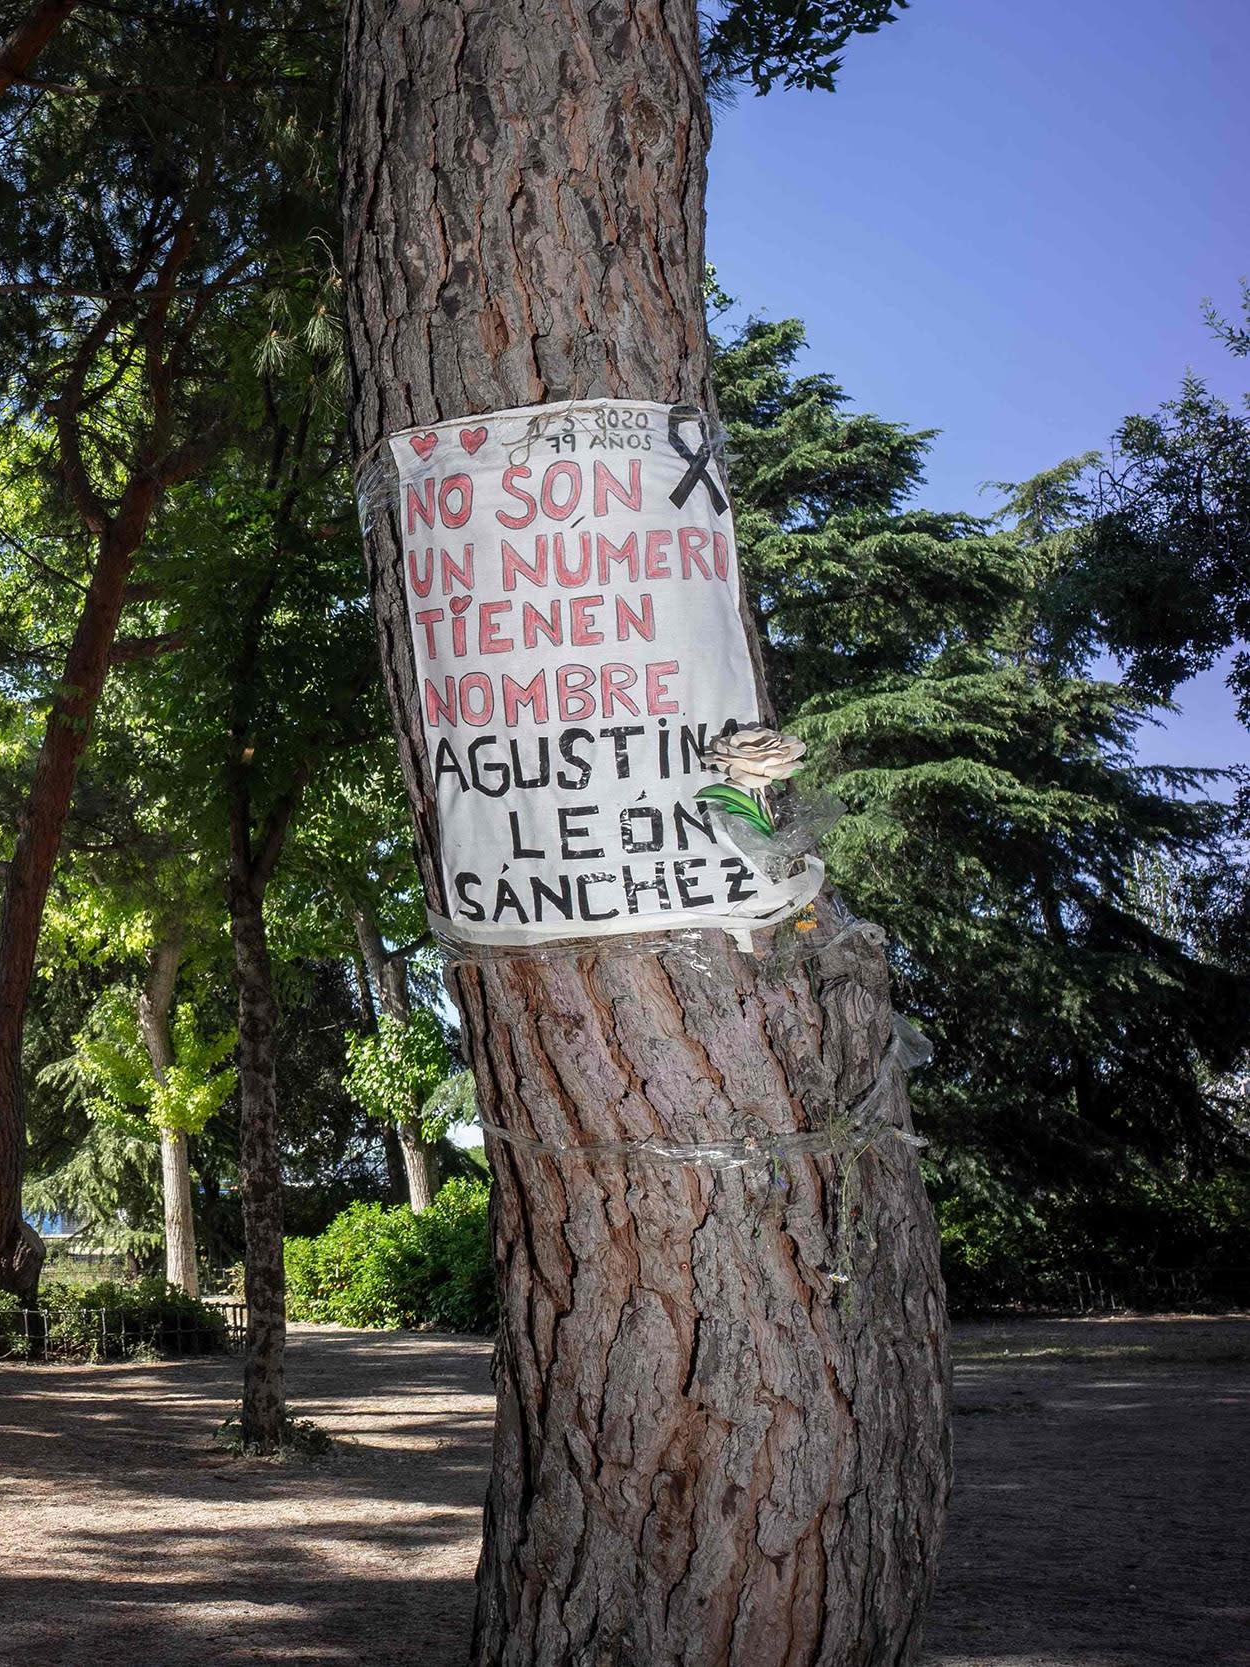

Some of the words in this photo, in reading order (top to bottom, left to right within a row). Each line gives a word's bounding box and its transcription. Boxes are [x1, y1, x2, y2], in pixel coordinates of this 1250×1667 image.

[546, 433, 577, 454] 79
[589, 432, 653, 451] AÑOS
[407, 472, 473, 535] NO
[495, 459, 642, 530] SON
[408, 543, 475, 598] UN
[425, 660, 680, 728] NOMBRE
[508, 790, 718, 861] LEÓN
[454, 857, 758, 924] SÁNCHEZ
